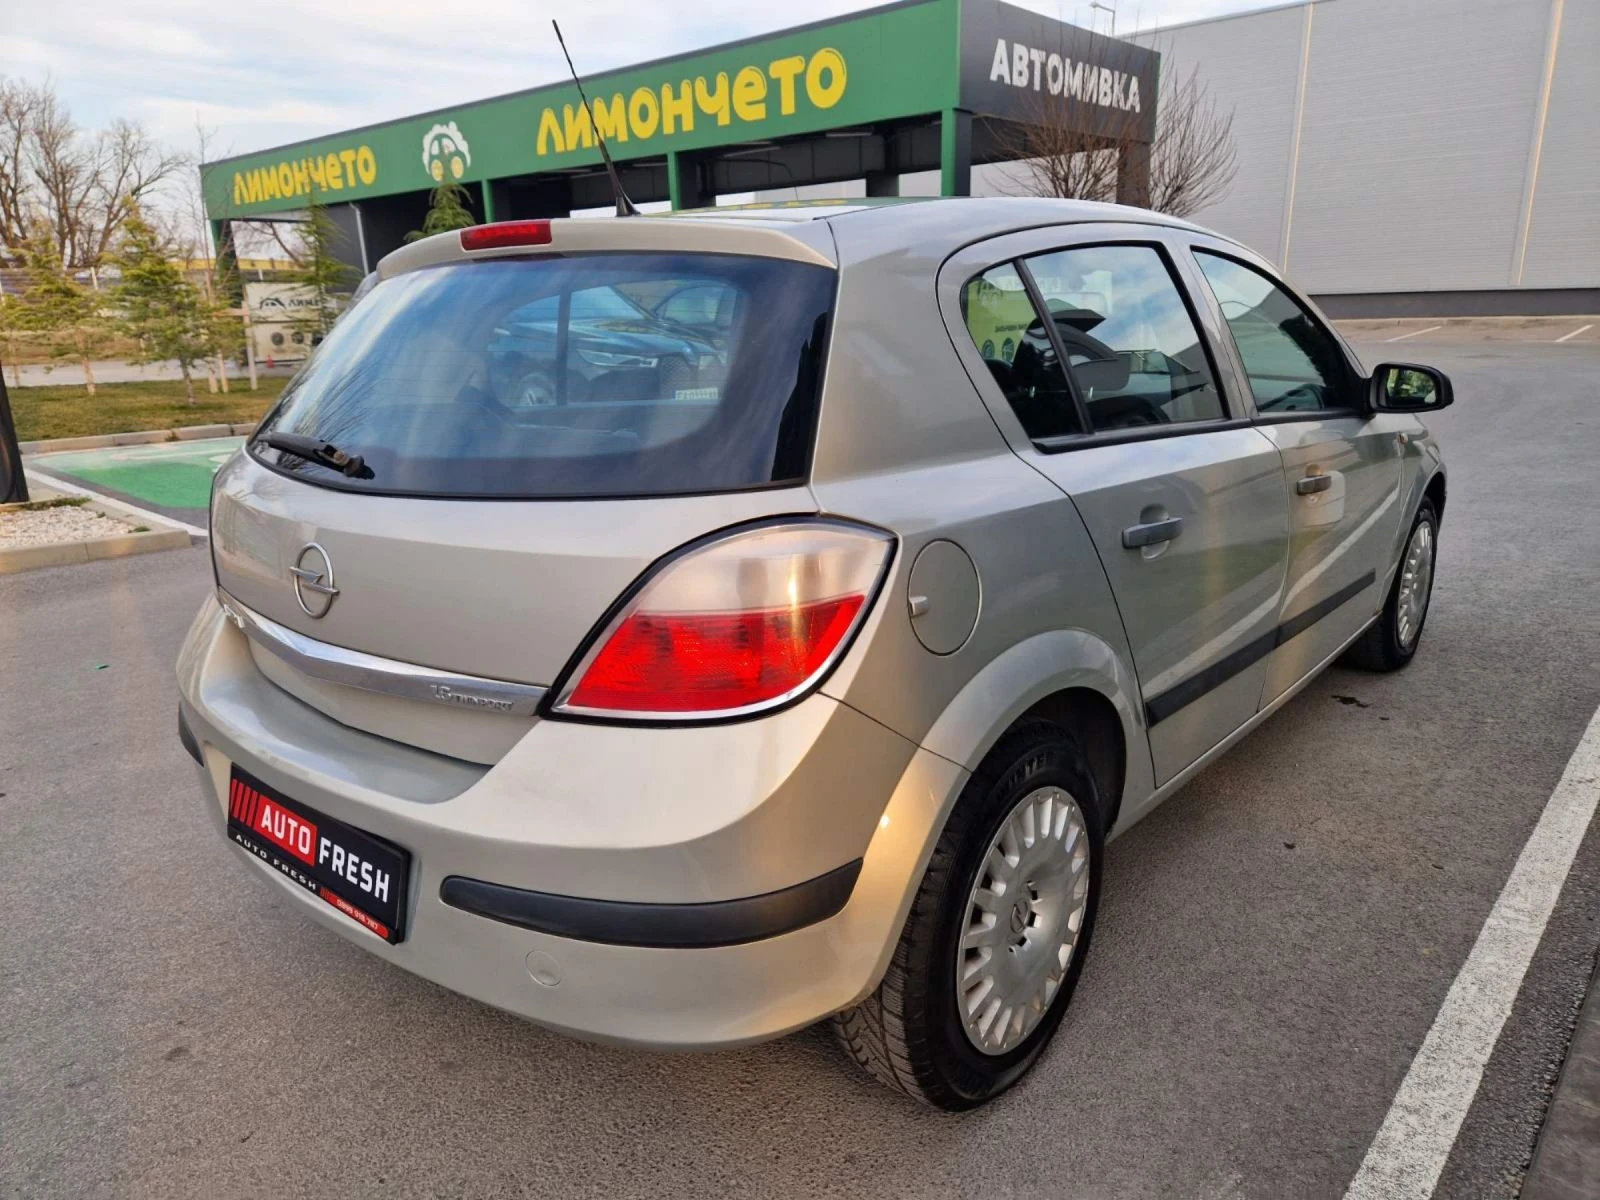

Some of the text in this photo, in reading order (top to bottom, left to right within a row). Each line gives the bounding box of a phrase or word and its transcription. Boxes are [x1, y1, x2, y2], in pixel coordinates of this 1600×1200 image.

[989, 38, 1141, 114] АВТОМИВКА
[235, 834, 317, 891] AUTO FRESH
[260, 804, 390, 903] AUTO FRESH
